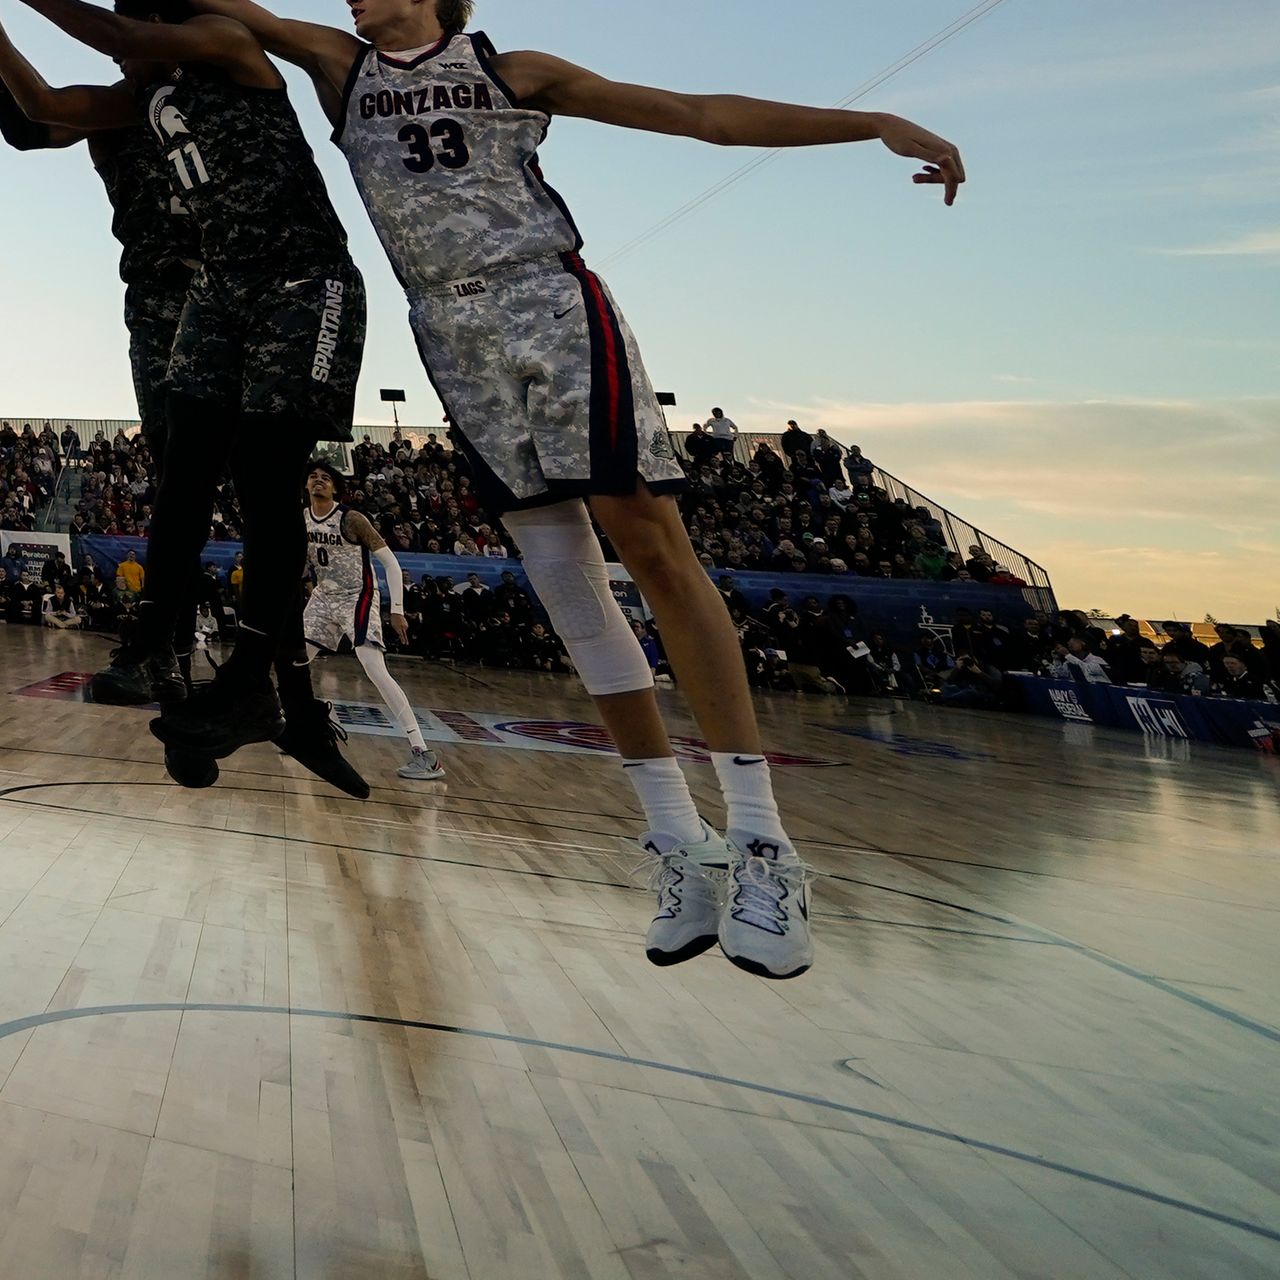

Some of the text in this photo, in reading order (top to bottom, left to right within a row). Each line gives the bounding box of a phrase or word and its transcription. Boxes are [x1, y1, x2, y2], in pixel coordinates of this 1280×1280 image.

[359, 83, 494, 120] GONZAGA
[397, 118, 470, 174] 33
[167, 141, 211, 191] 11
[453, 280, 486, 297] ZAGS
[311, 278, 345, 384] SPARTANS
[317, 547, 328, 567] 0
[1048, 688, 1070, 703] NAVY
[1054, 701, 1089, 717] FEDERAL
